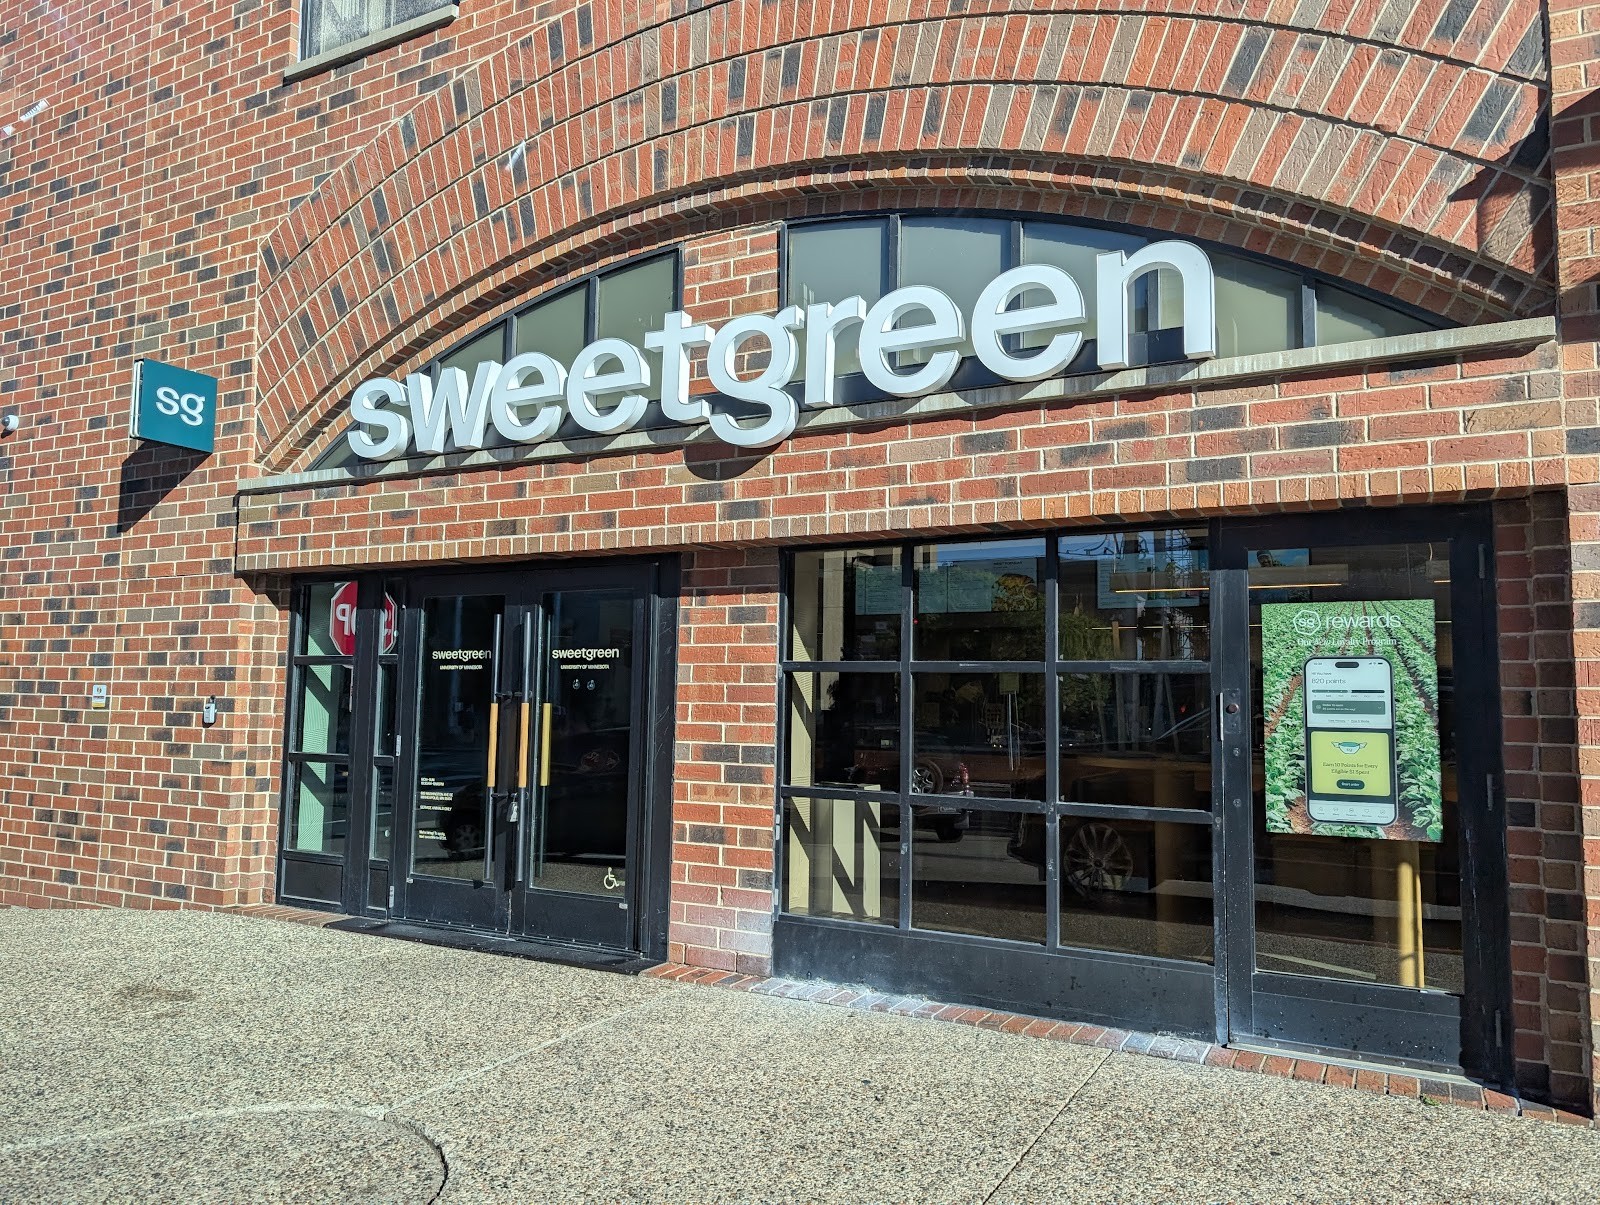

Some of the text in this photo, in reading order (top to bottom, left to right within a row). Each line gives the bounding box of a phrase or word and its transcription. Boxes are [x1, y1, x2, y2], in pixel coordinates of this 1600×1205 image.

[347, 239, 1217, 461] sweetgreen
[155, 386, 206, 426] sg
[1298, 611, 1402, 629] sg rewards
[1362, 638, 1397, 647] Program
[432, 649, 492, 662] sweetgreen
[551, 647, 620, 661] sweetgreen
